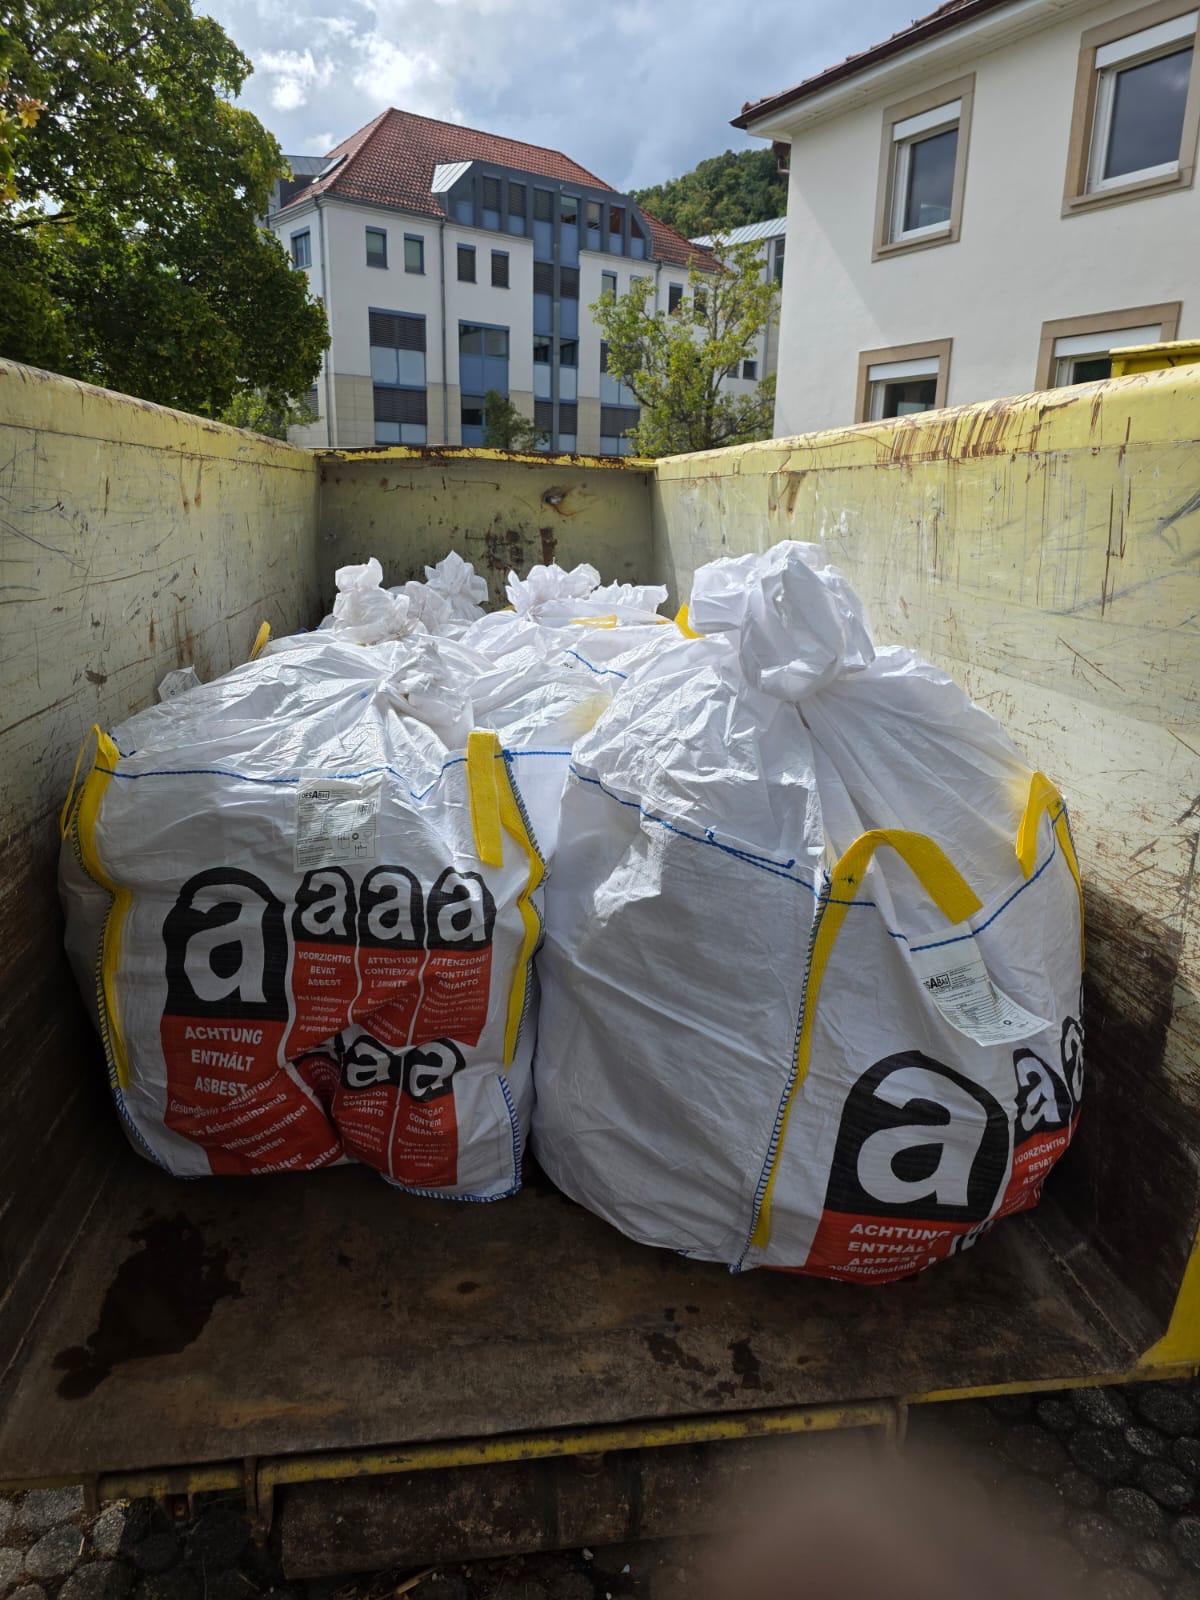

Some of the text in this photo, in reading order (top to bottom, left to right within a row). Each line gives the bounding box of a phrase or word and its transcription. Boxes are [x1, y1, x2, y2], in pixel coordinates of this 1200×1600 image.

[301, 872, 347, 936] a
[367, 872, 416, 941] a
[437, 873, 487, 942] a
[184, 883, 267, 1003] a
[298, 951, 352, 965] VOORZICHTIG
[367, 956, 419, 965] ATTENTION
[310, 966, 336, 976] BEVAT
[434, 967, 483, 979] CONTIENE
[438, 979, 480, 990] AMIANTO
[184, 1026, 264, 1045] ACHTUNG
[191, 1049, 256, 1073] ENTHÄLT
[346, 1042, 391, 1088] a
[409, 1042, 457, 1097] a
[194, 1076, 250, 1097] ASBEST
[857, 1066, 988, 1206] a
[1028, 1155, 1053, 1173] BEVAT
